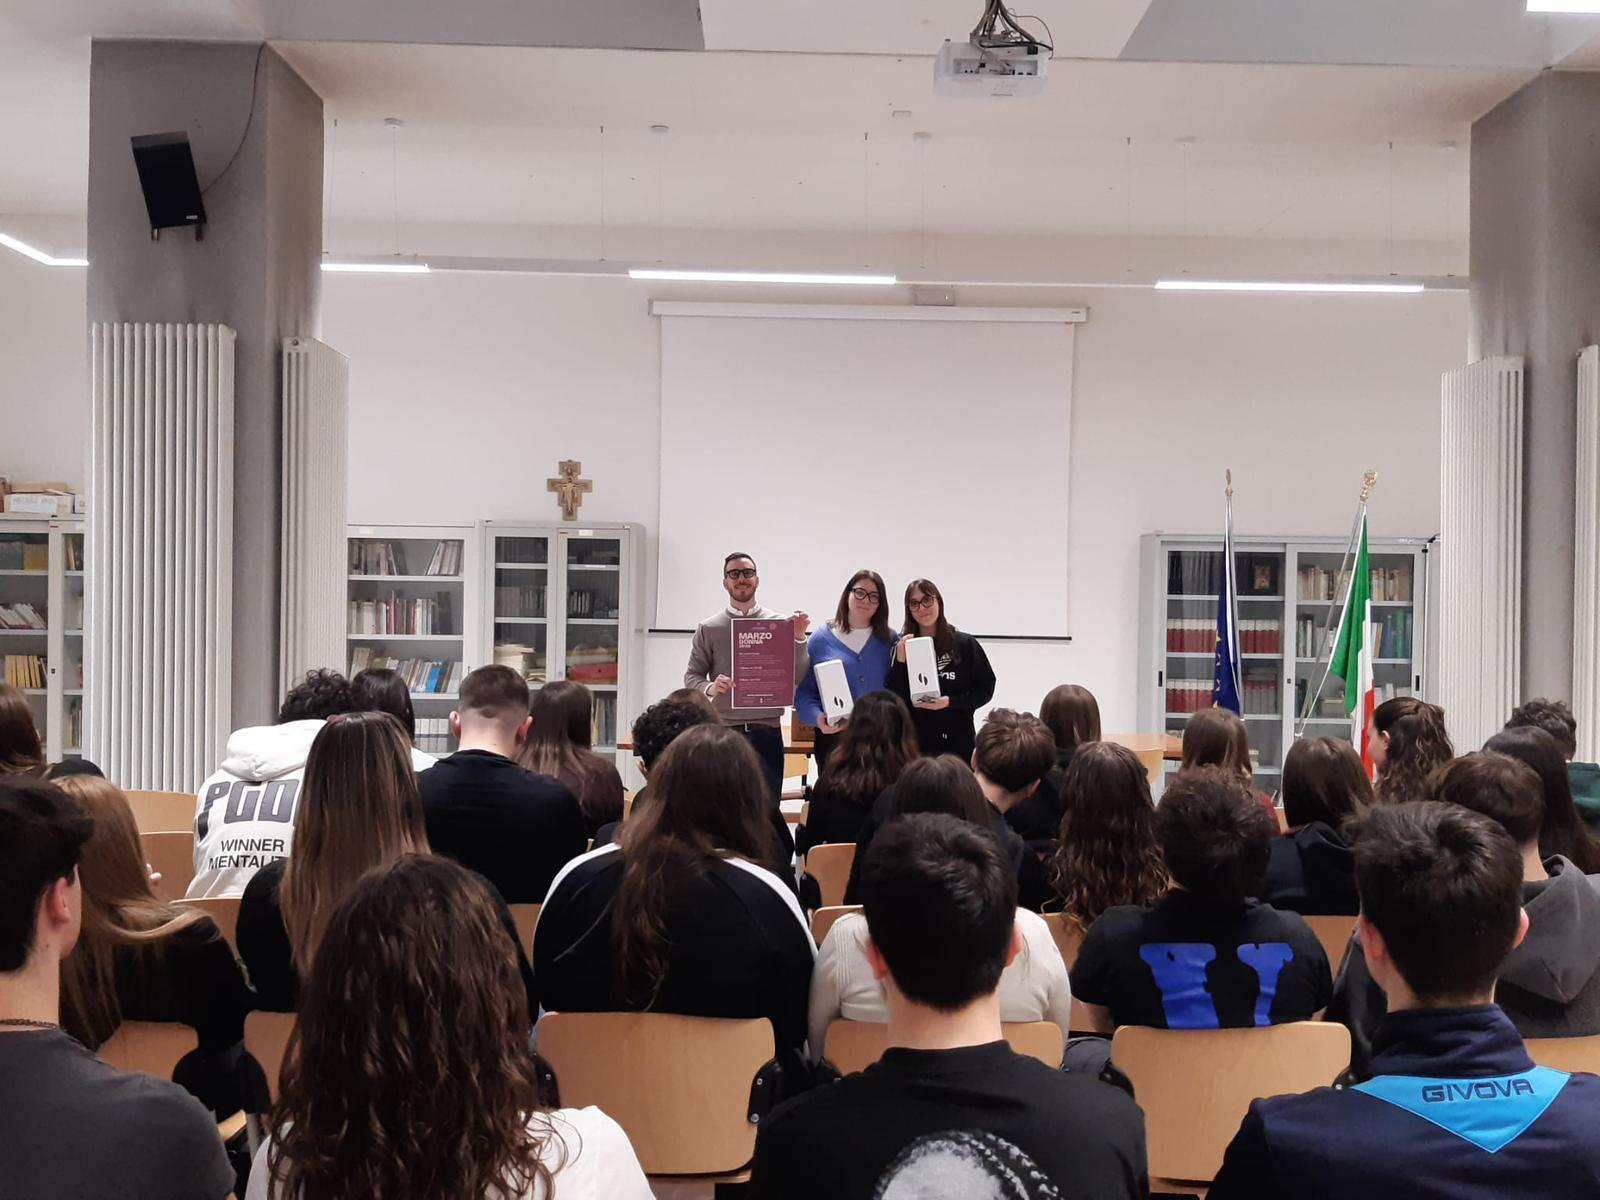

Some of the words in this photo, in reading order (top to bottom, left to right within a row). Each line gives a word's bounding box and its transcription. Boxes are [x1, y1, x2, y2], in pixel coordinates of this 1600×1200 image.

[738, 632, 772, 640] MARZO
[220, 838, 285, 852] WINNER
[208, 855, 290, 870] MENTALI
[1421, 1078, 1535, 1103] GIVOVA
